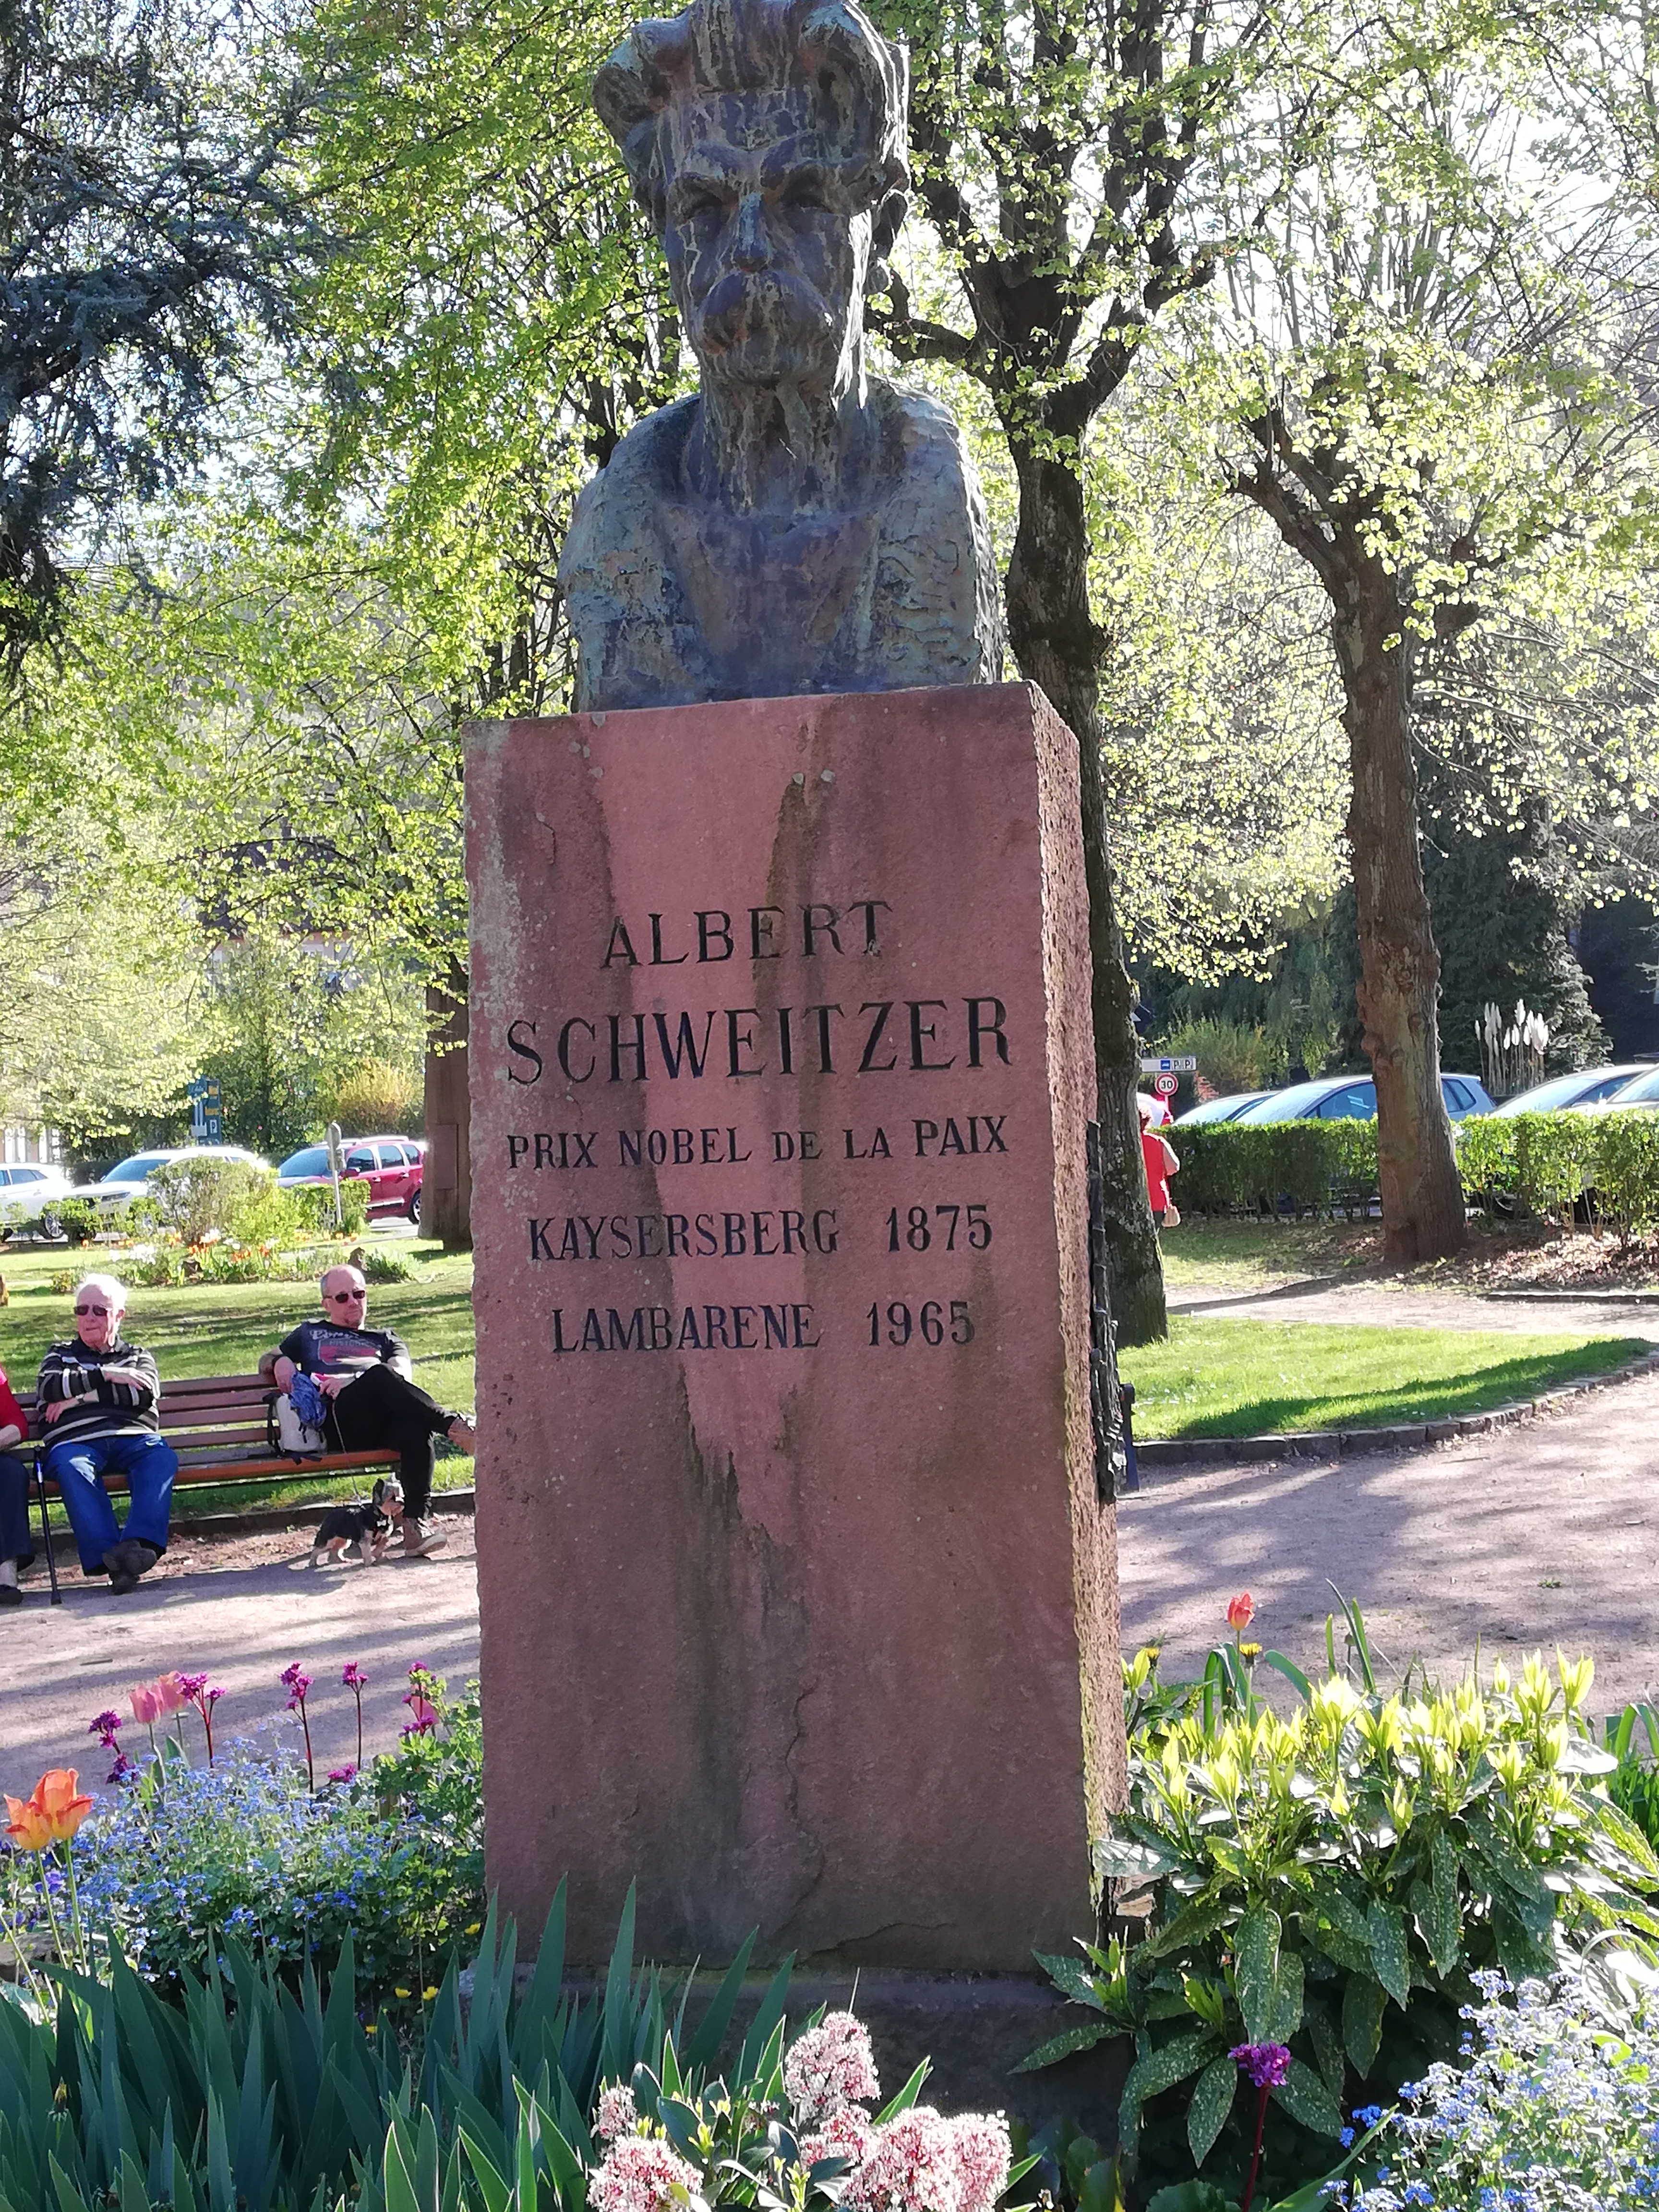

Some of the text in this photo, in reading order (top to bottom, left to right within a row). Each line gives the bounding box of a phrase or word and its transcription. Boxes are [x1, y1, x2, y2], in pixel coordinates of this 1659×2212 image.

[600, 901, 893, 968] ALBERT
[506, 996, 1012, 1086] SCHWEITZER
[1161, 1081, 1173, 1089] 30
[508, 1115, 1010, 1170] PRIX NOBEL DE LA PAIX
[528, 1205, 992, 1262] KAYSERSBERG 1875
[552, 1301, 976, 1354] LAMBARENE 1965
